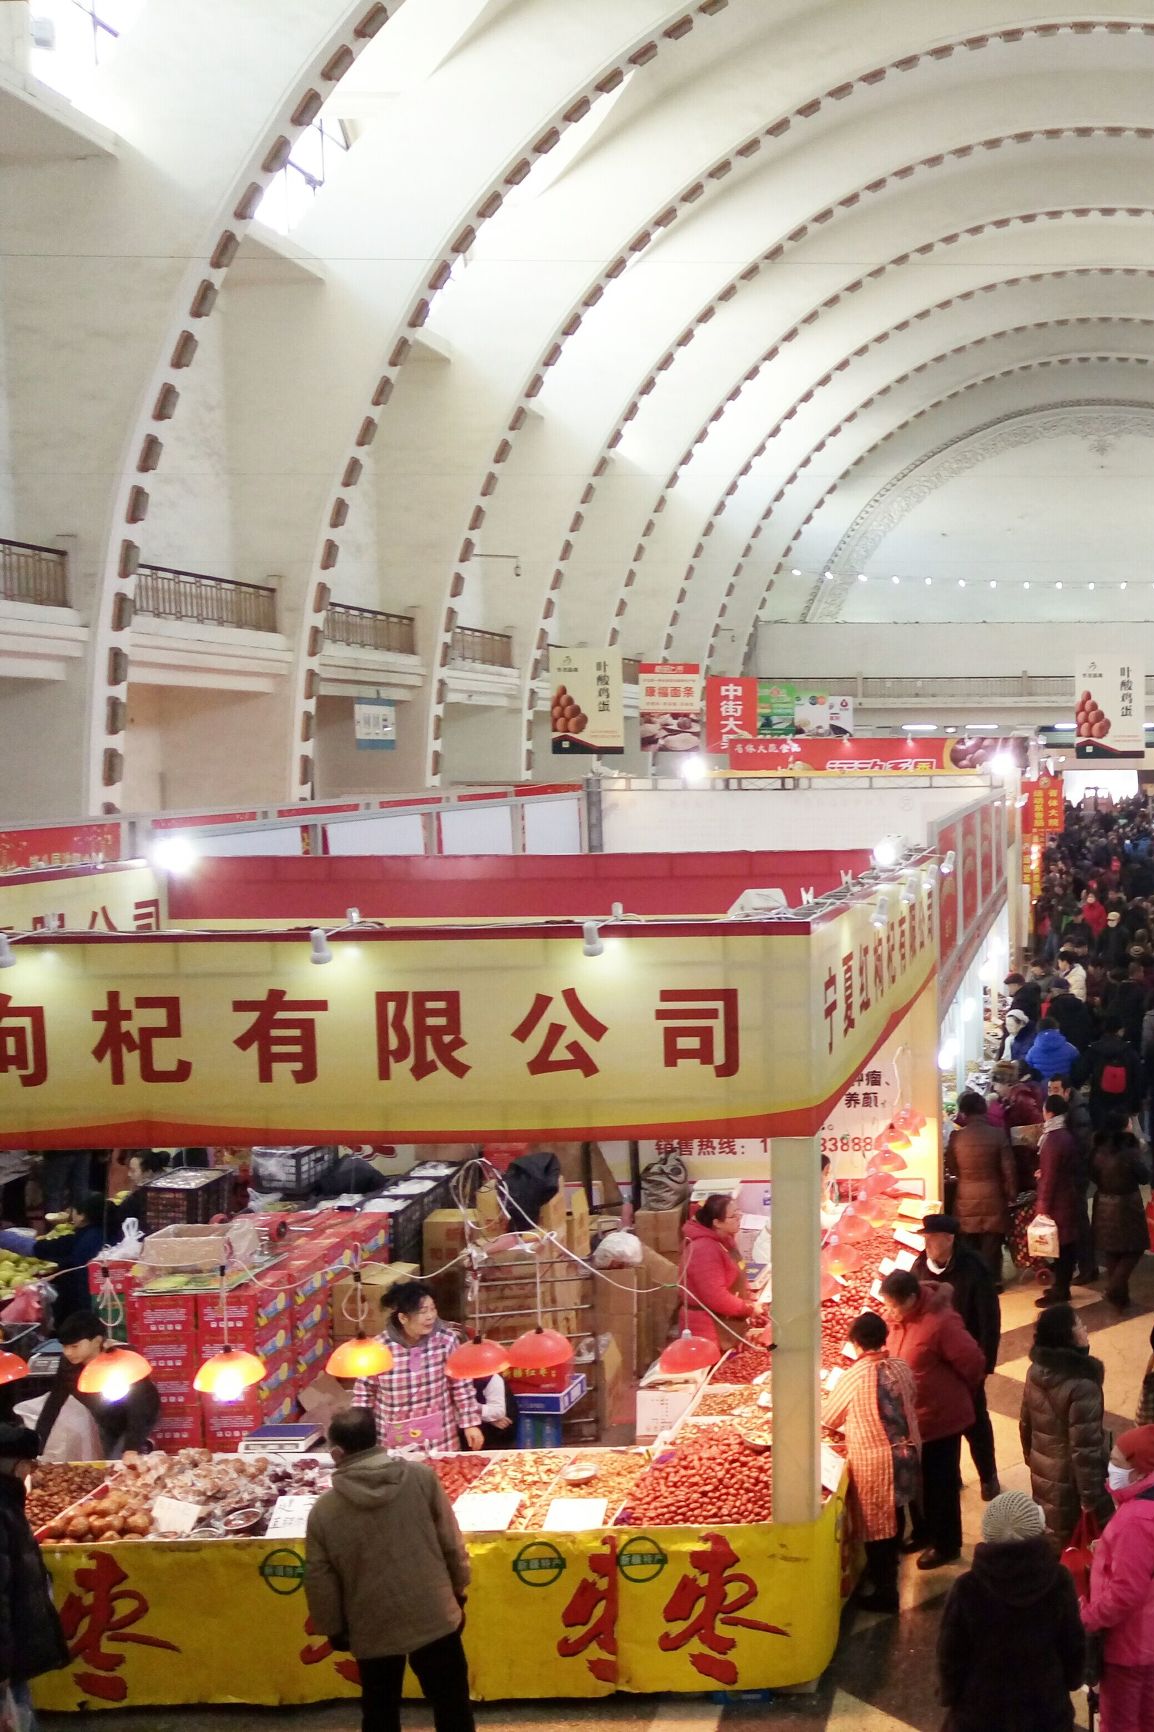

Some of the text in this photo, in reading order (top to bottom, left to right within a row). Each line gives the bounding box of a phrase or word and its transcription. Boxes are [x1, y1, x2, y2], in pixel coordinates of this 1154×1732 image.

[823, 889, 933, 1055] 宁夏红枸杞有限公司
